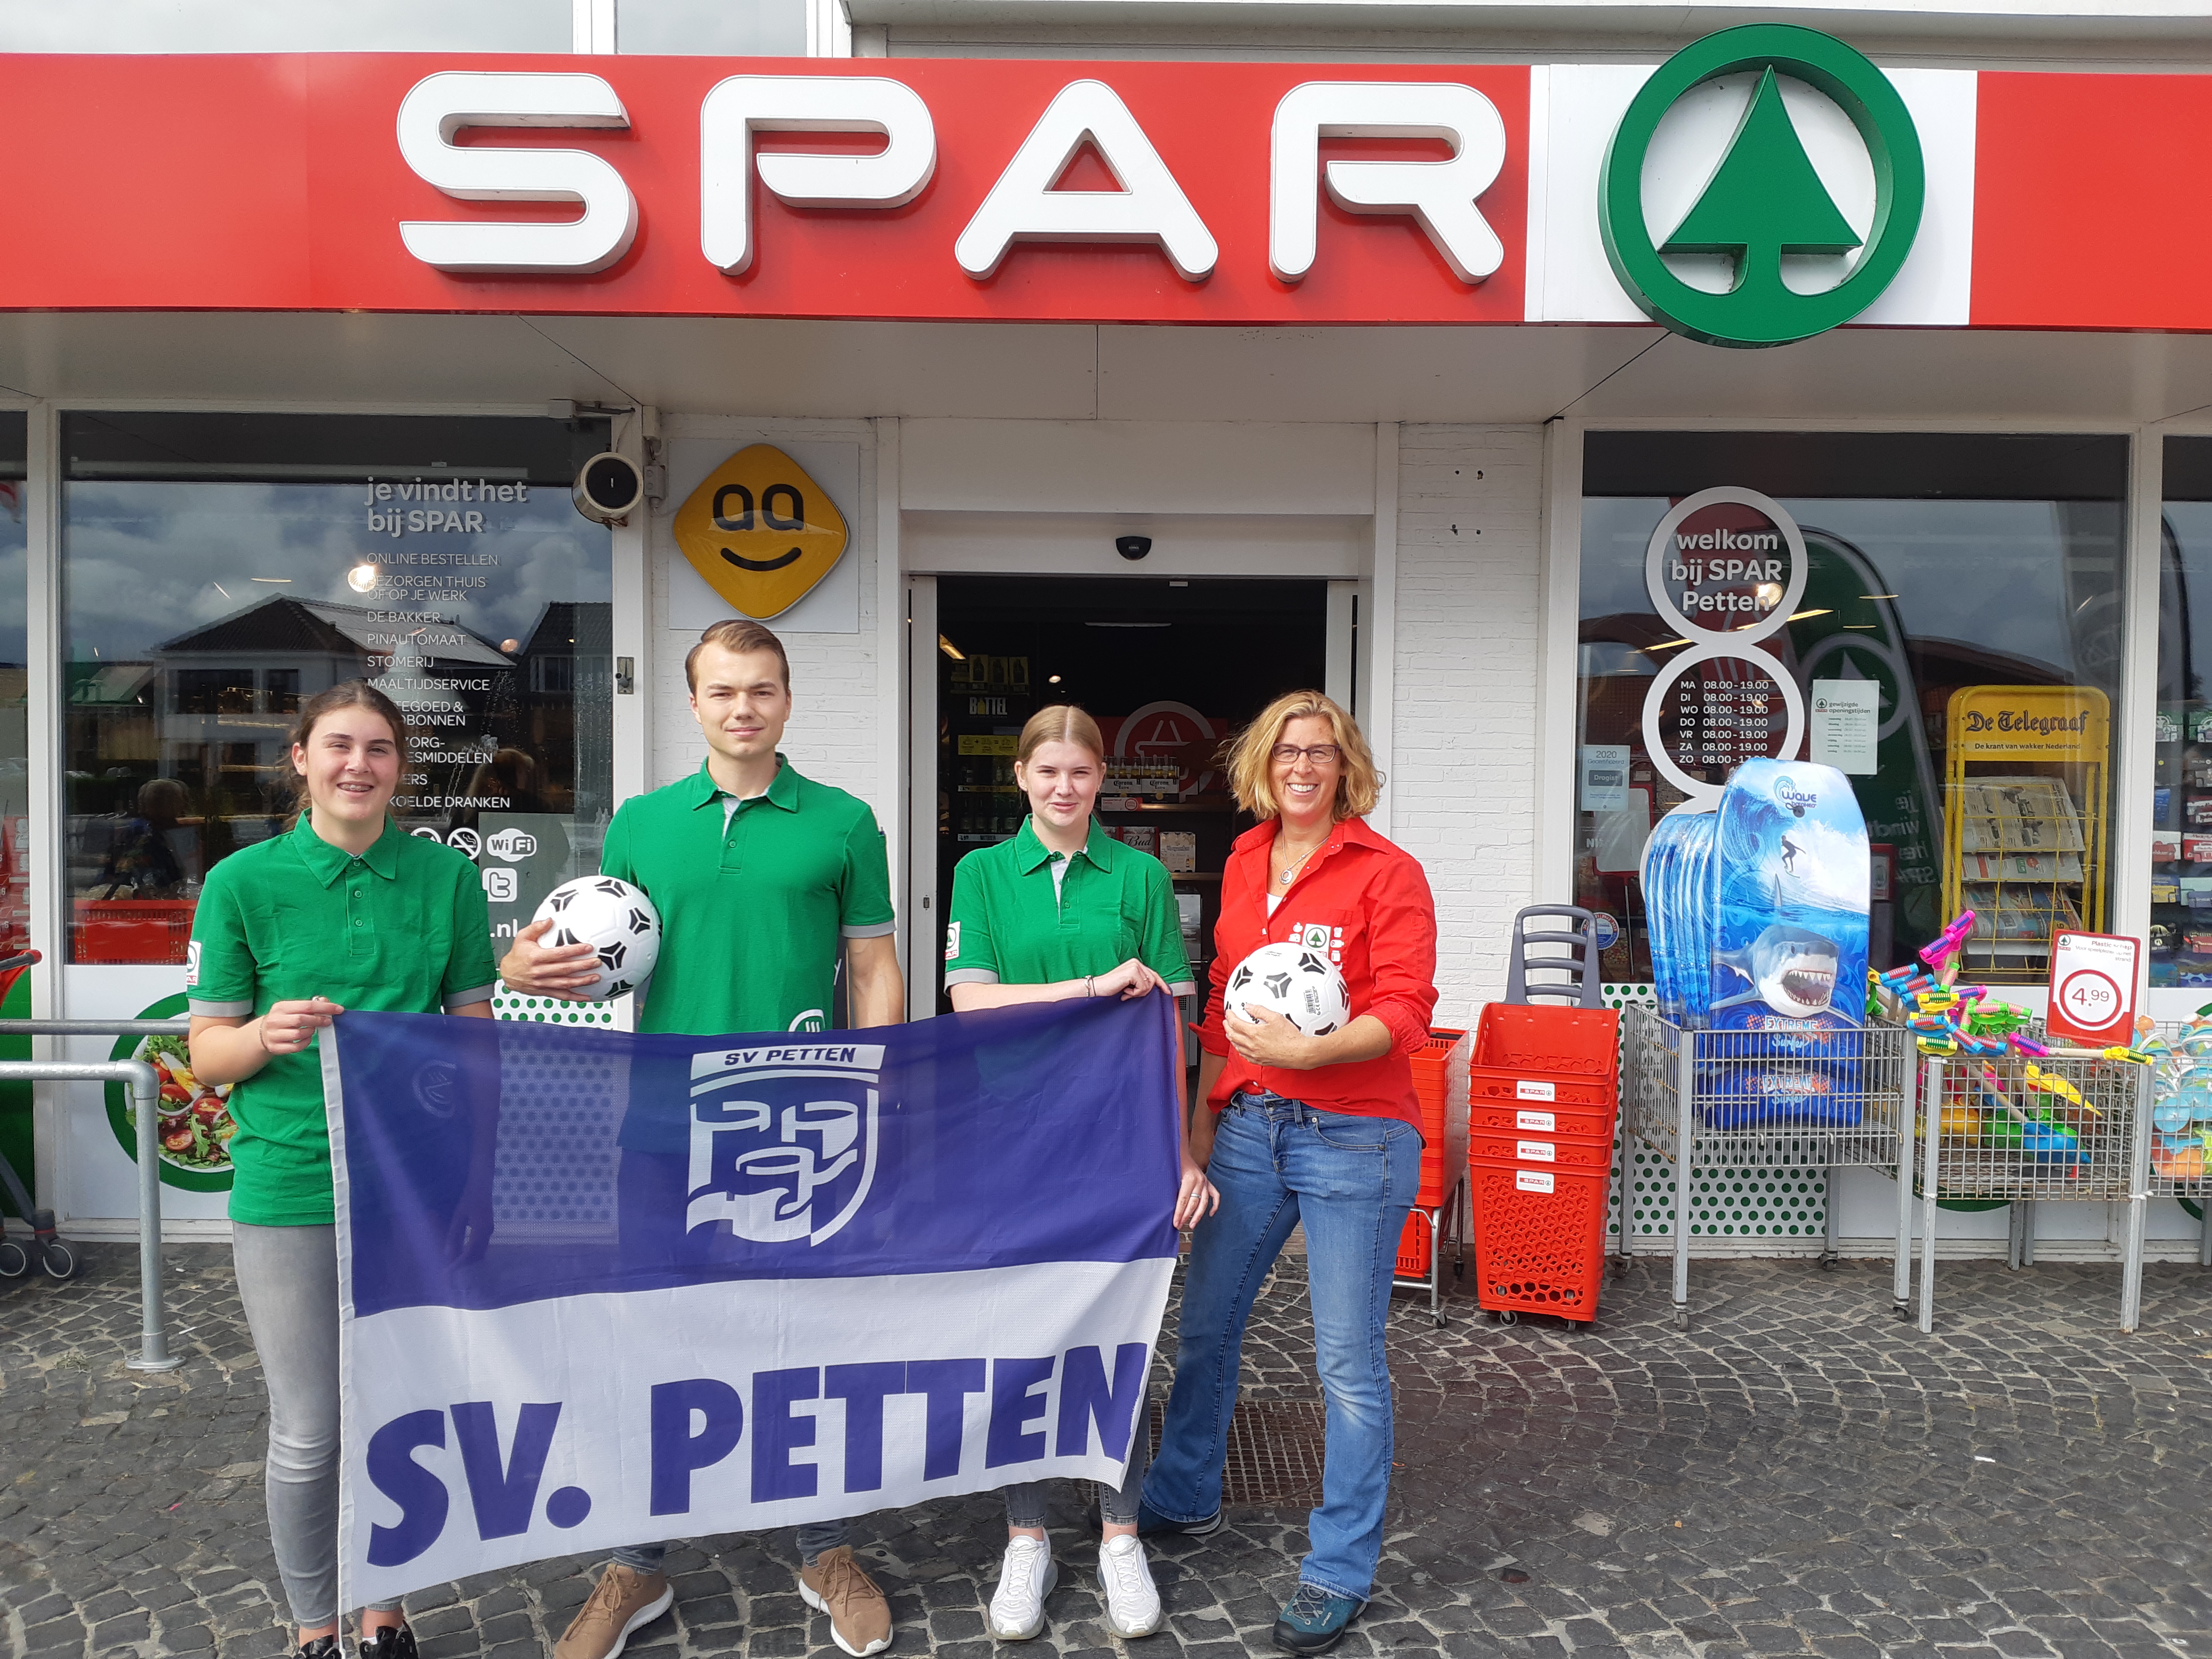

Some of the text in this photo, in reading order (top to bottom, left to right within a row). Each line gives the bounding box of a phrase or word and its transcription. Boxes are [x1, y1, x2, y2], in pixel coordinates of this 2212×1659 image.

[397, 71, 1508, 282] SPAR
[364, 476, 527, 506] je vindt het
[368, 508, 483, 538] bij SPAR
[1677, 529, 1778, 550] welkom
[367, 553, 498, 565] ONLINE BESTELLEN
[1671, 559, 1782, 586] bij SPAR
[445, 576, 486, 588] THUIS
[367, 589, 467, 601] OF OP JE WERK
[1683, 591, 1769, 612] Petten
[368, 611, 440, 623] DE BAKKER
[367, 633, 467, 646] PINAUTOMAAT
[367, 656, 434, 668] STOMERIJ
[368, 678, 490, 691] MAALTIJDSERVICE
[1681, 681, 1696, 689] MA
[1704, 681, 1732, 689] 08.00
[1740, 681, 1768, 689] 19.00
[396, 701, 464, 712] TEGOED &
[1681, 706, 1698, 714] WO
[1703, 706, 1732, 714] 08.00
[1740, 706, 1768, 714] 19.00
[1680, 718, 1695, 726] DO
[1703, 718, 1731, 726] 08.00
[1740, 718, 1768, 726] 19.00
[1965, 709, 2090, 736] De Telegraaf
[408, 752, 493, 764] ESMIDDELEN
[1596, 750, 1617, 759] 2020
[1680, 755, 1694, 763] ZO
[1702, 755, 1731, 763] 08.00
[445, 796, 510, 808] DRANKEN
[1126, 835, 1152, 847] Bud
[724, 1047, 857, 1065] SV PETTEN
[366, 1343, 1148, 1567] SV. PETTEN
